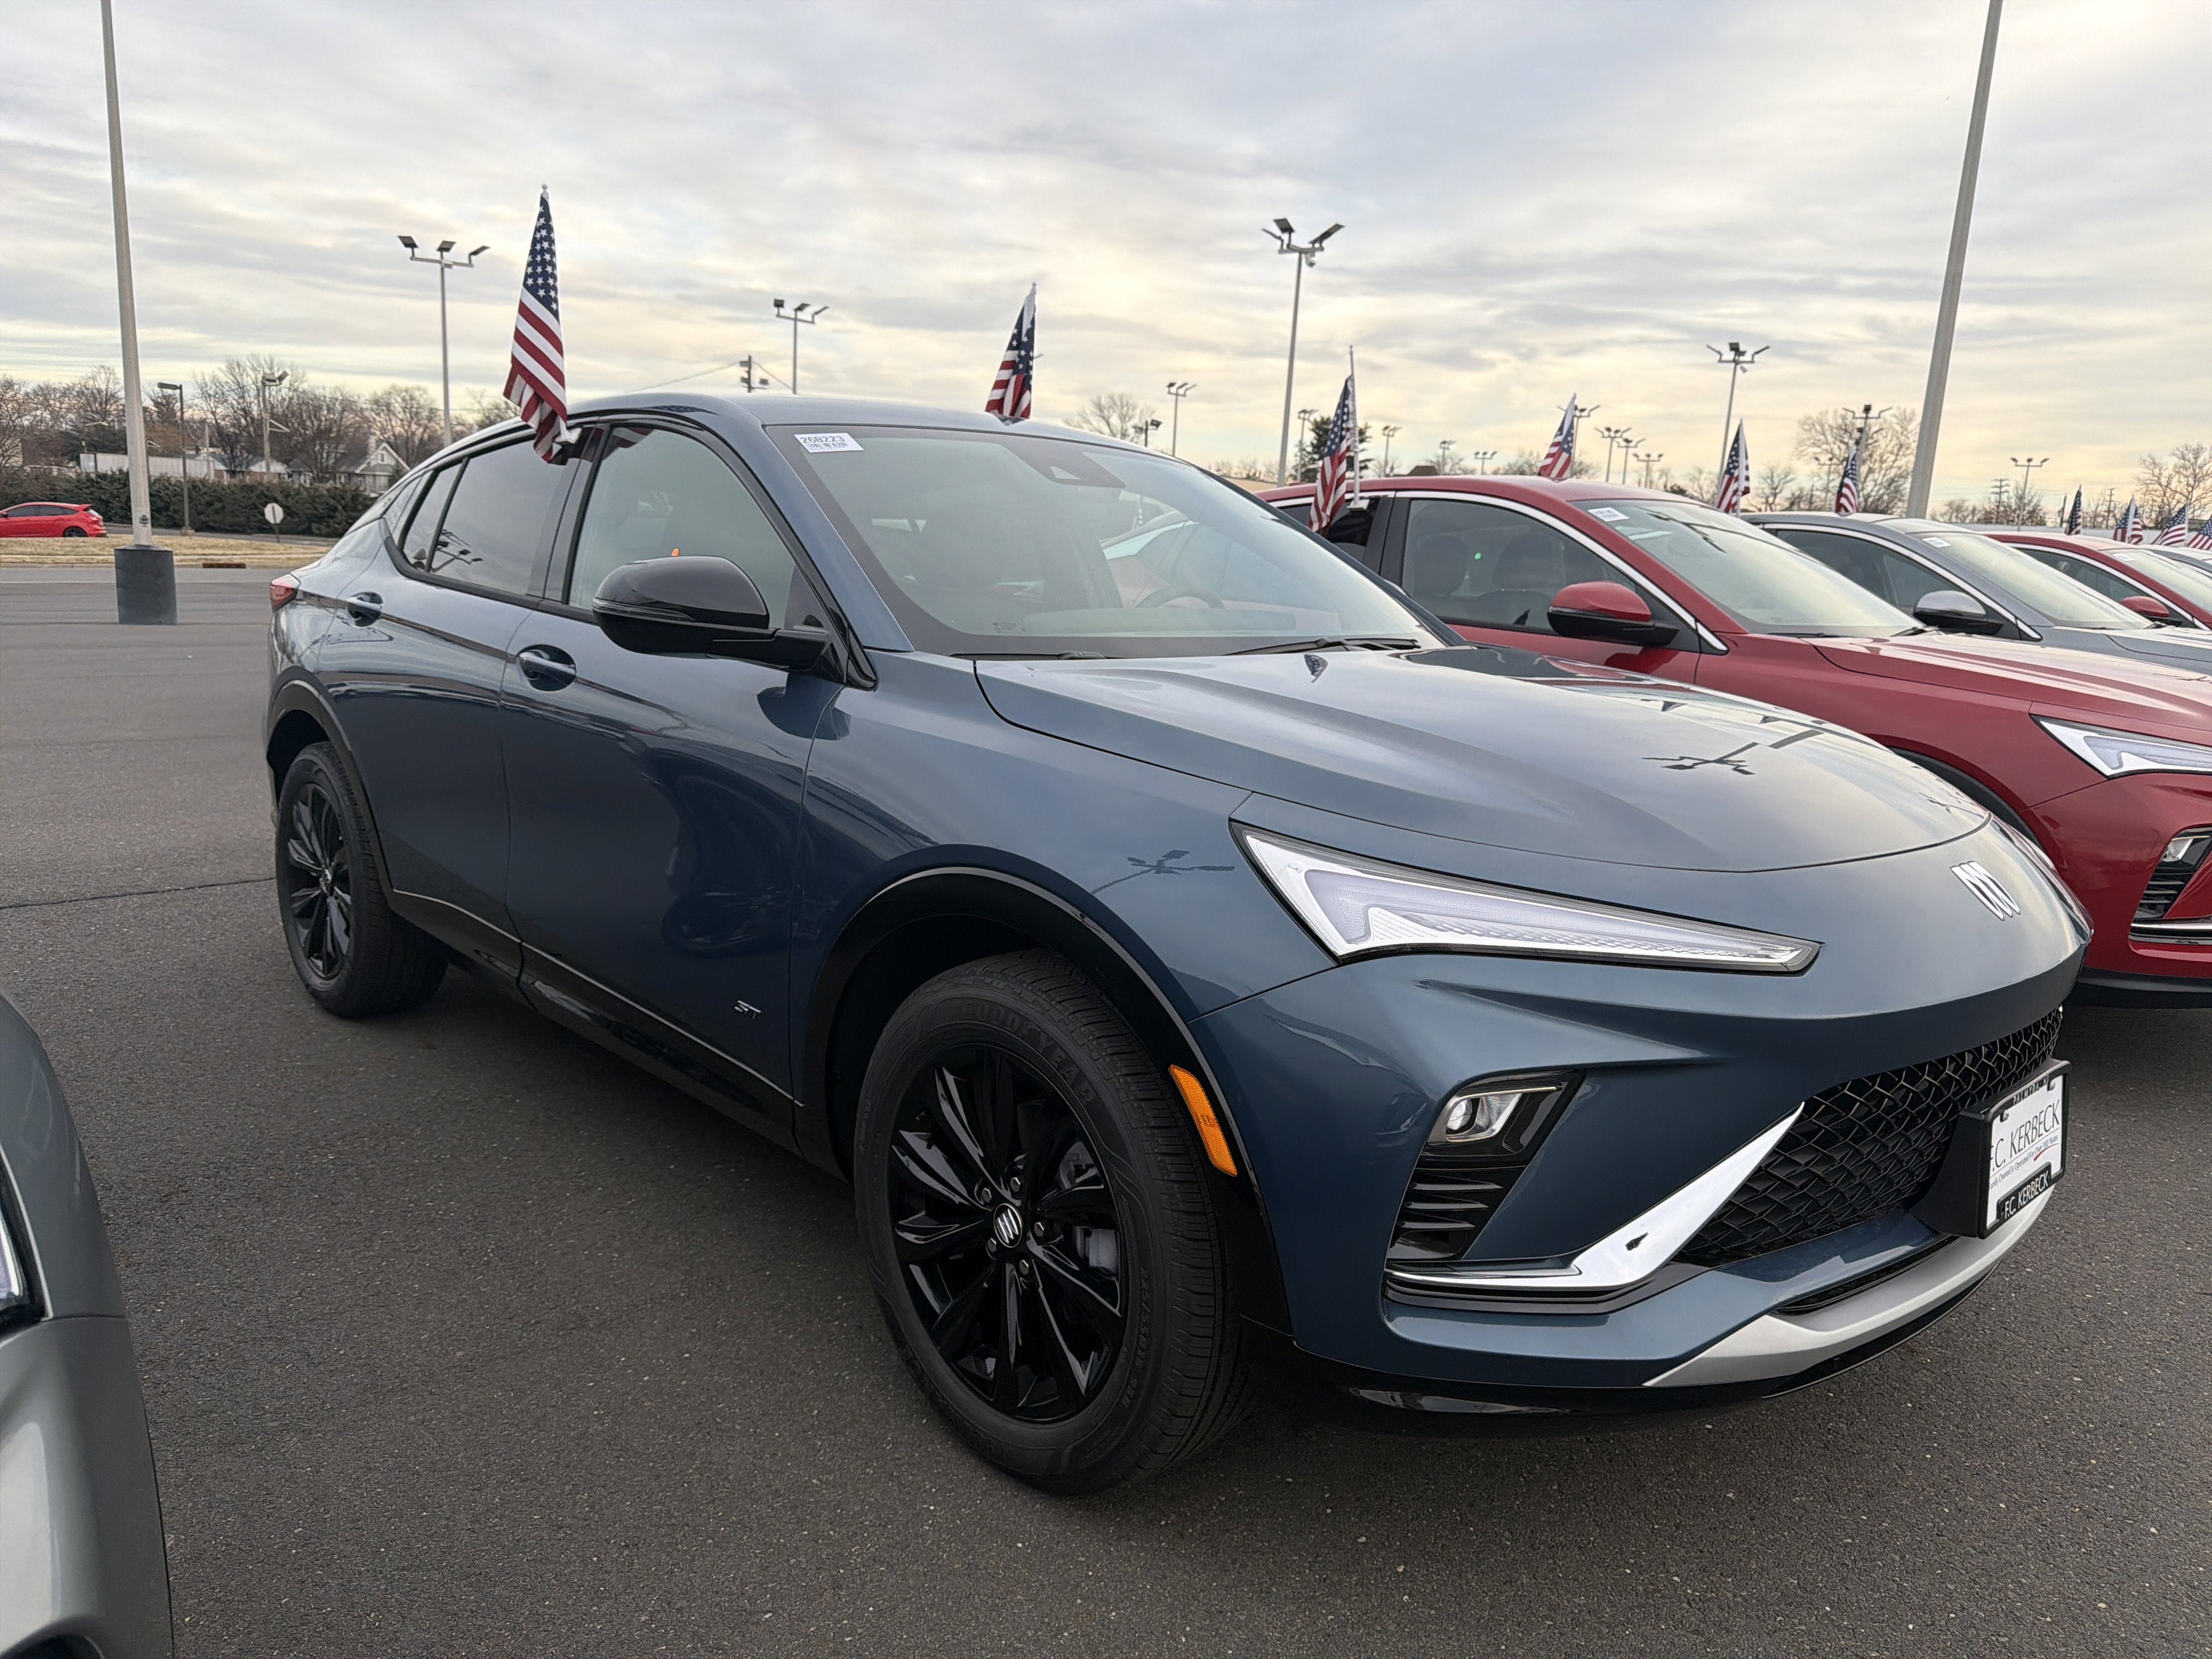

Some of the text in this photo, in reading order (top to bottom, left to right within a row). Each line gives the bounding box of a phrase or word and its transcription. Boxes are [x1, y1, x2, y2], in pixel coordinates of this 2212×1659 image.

[961, 1000, 1096, 1103] GOODYEAR
[1990, 1099, 2059, 1172] .C. KERBECK
[2018, 1170, 2049, 1209] KERBECK
